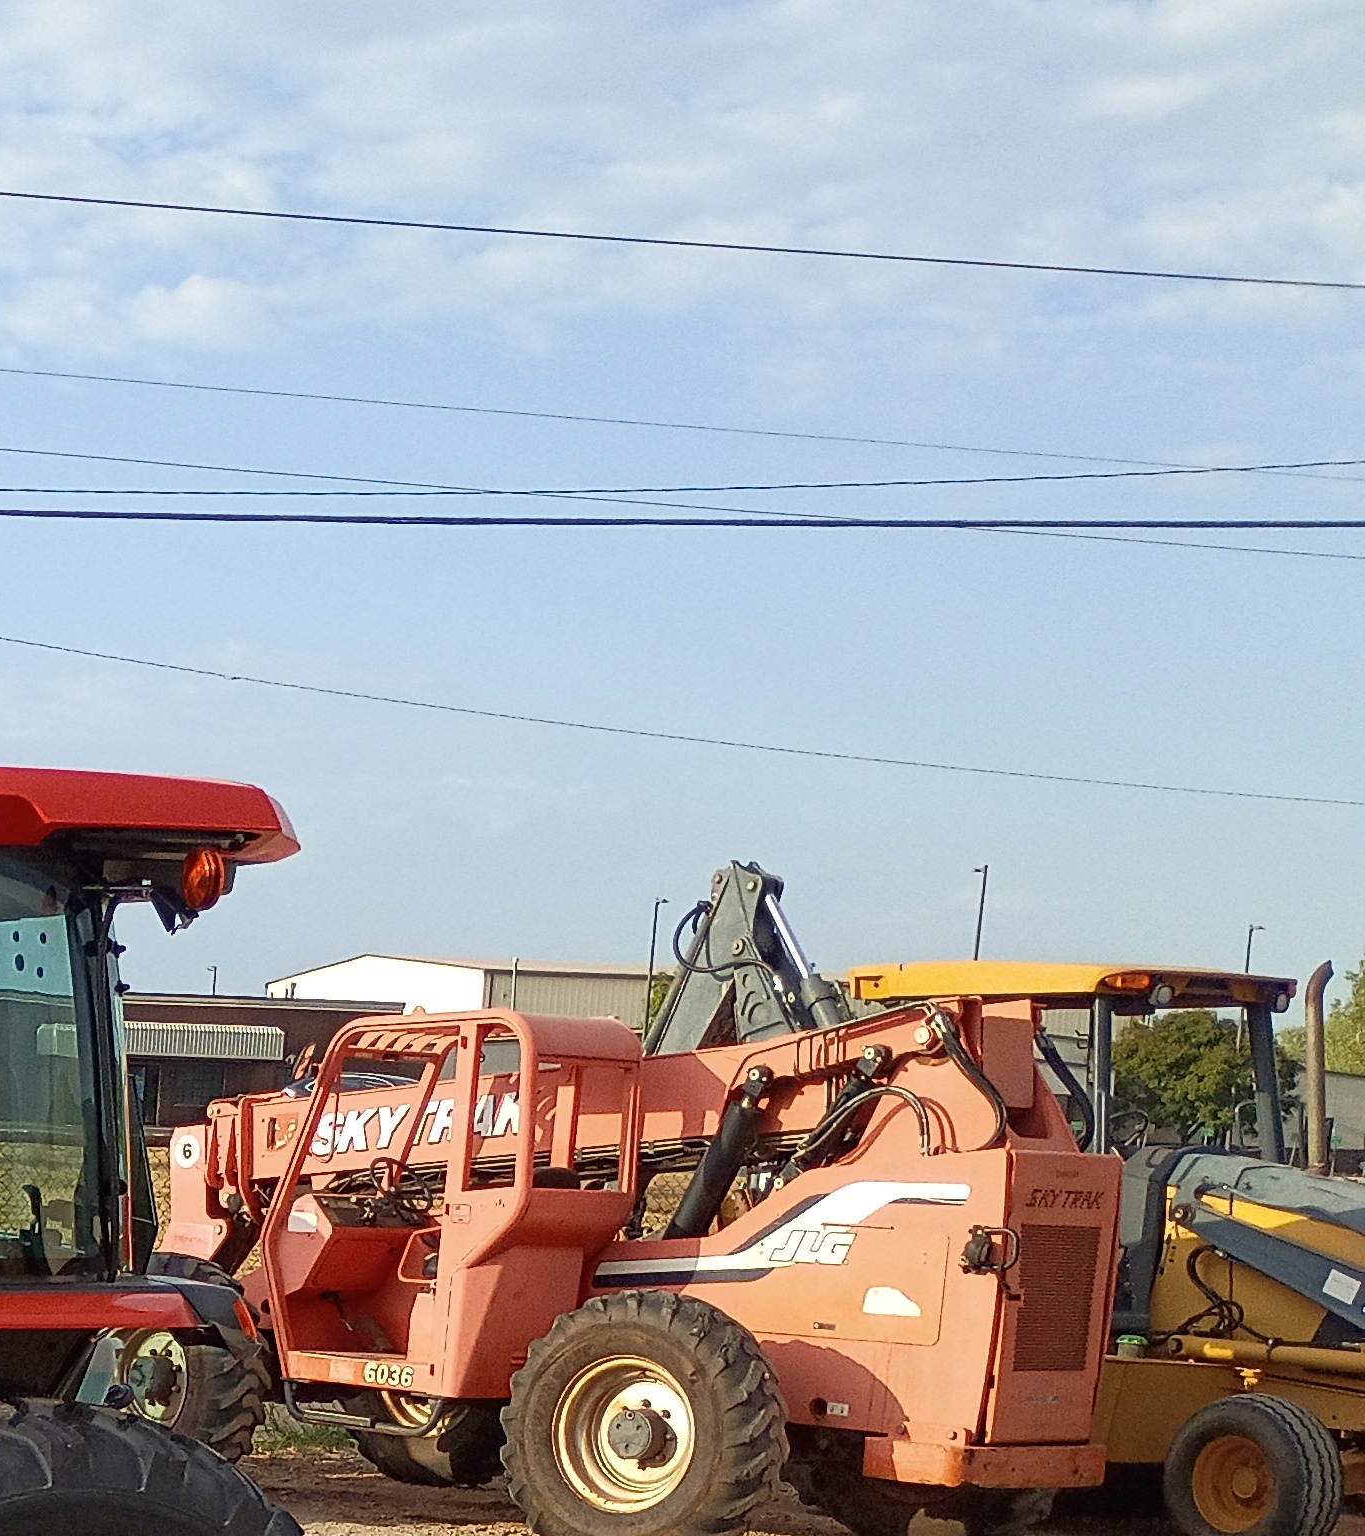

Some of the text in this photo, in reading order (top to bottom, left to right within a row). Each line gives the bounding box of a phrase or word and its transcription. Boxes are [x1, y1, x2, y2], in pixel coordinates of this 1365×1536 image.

[182, 1142, 193, 1159] 6
[769, 1229, 857, 1266] JLG
[364, 1361, 414, 1388] 6036
